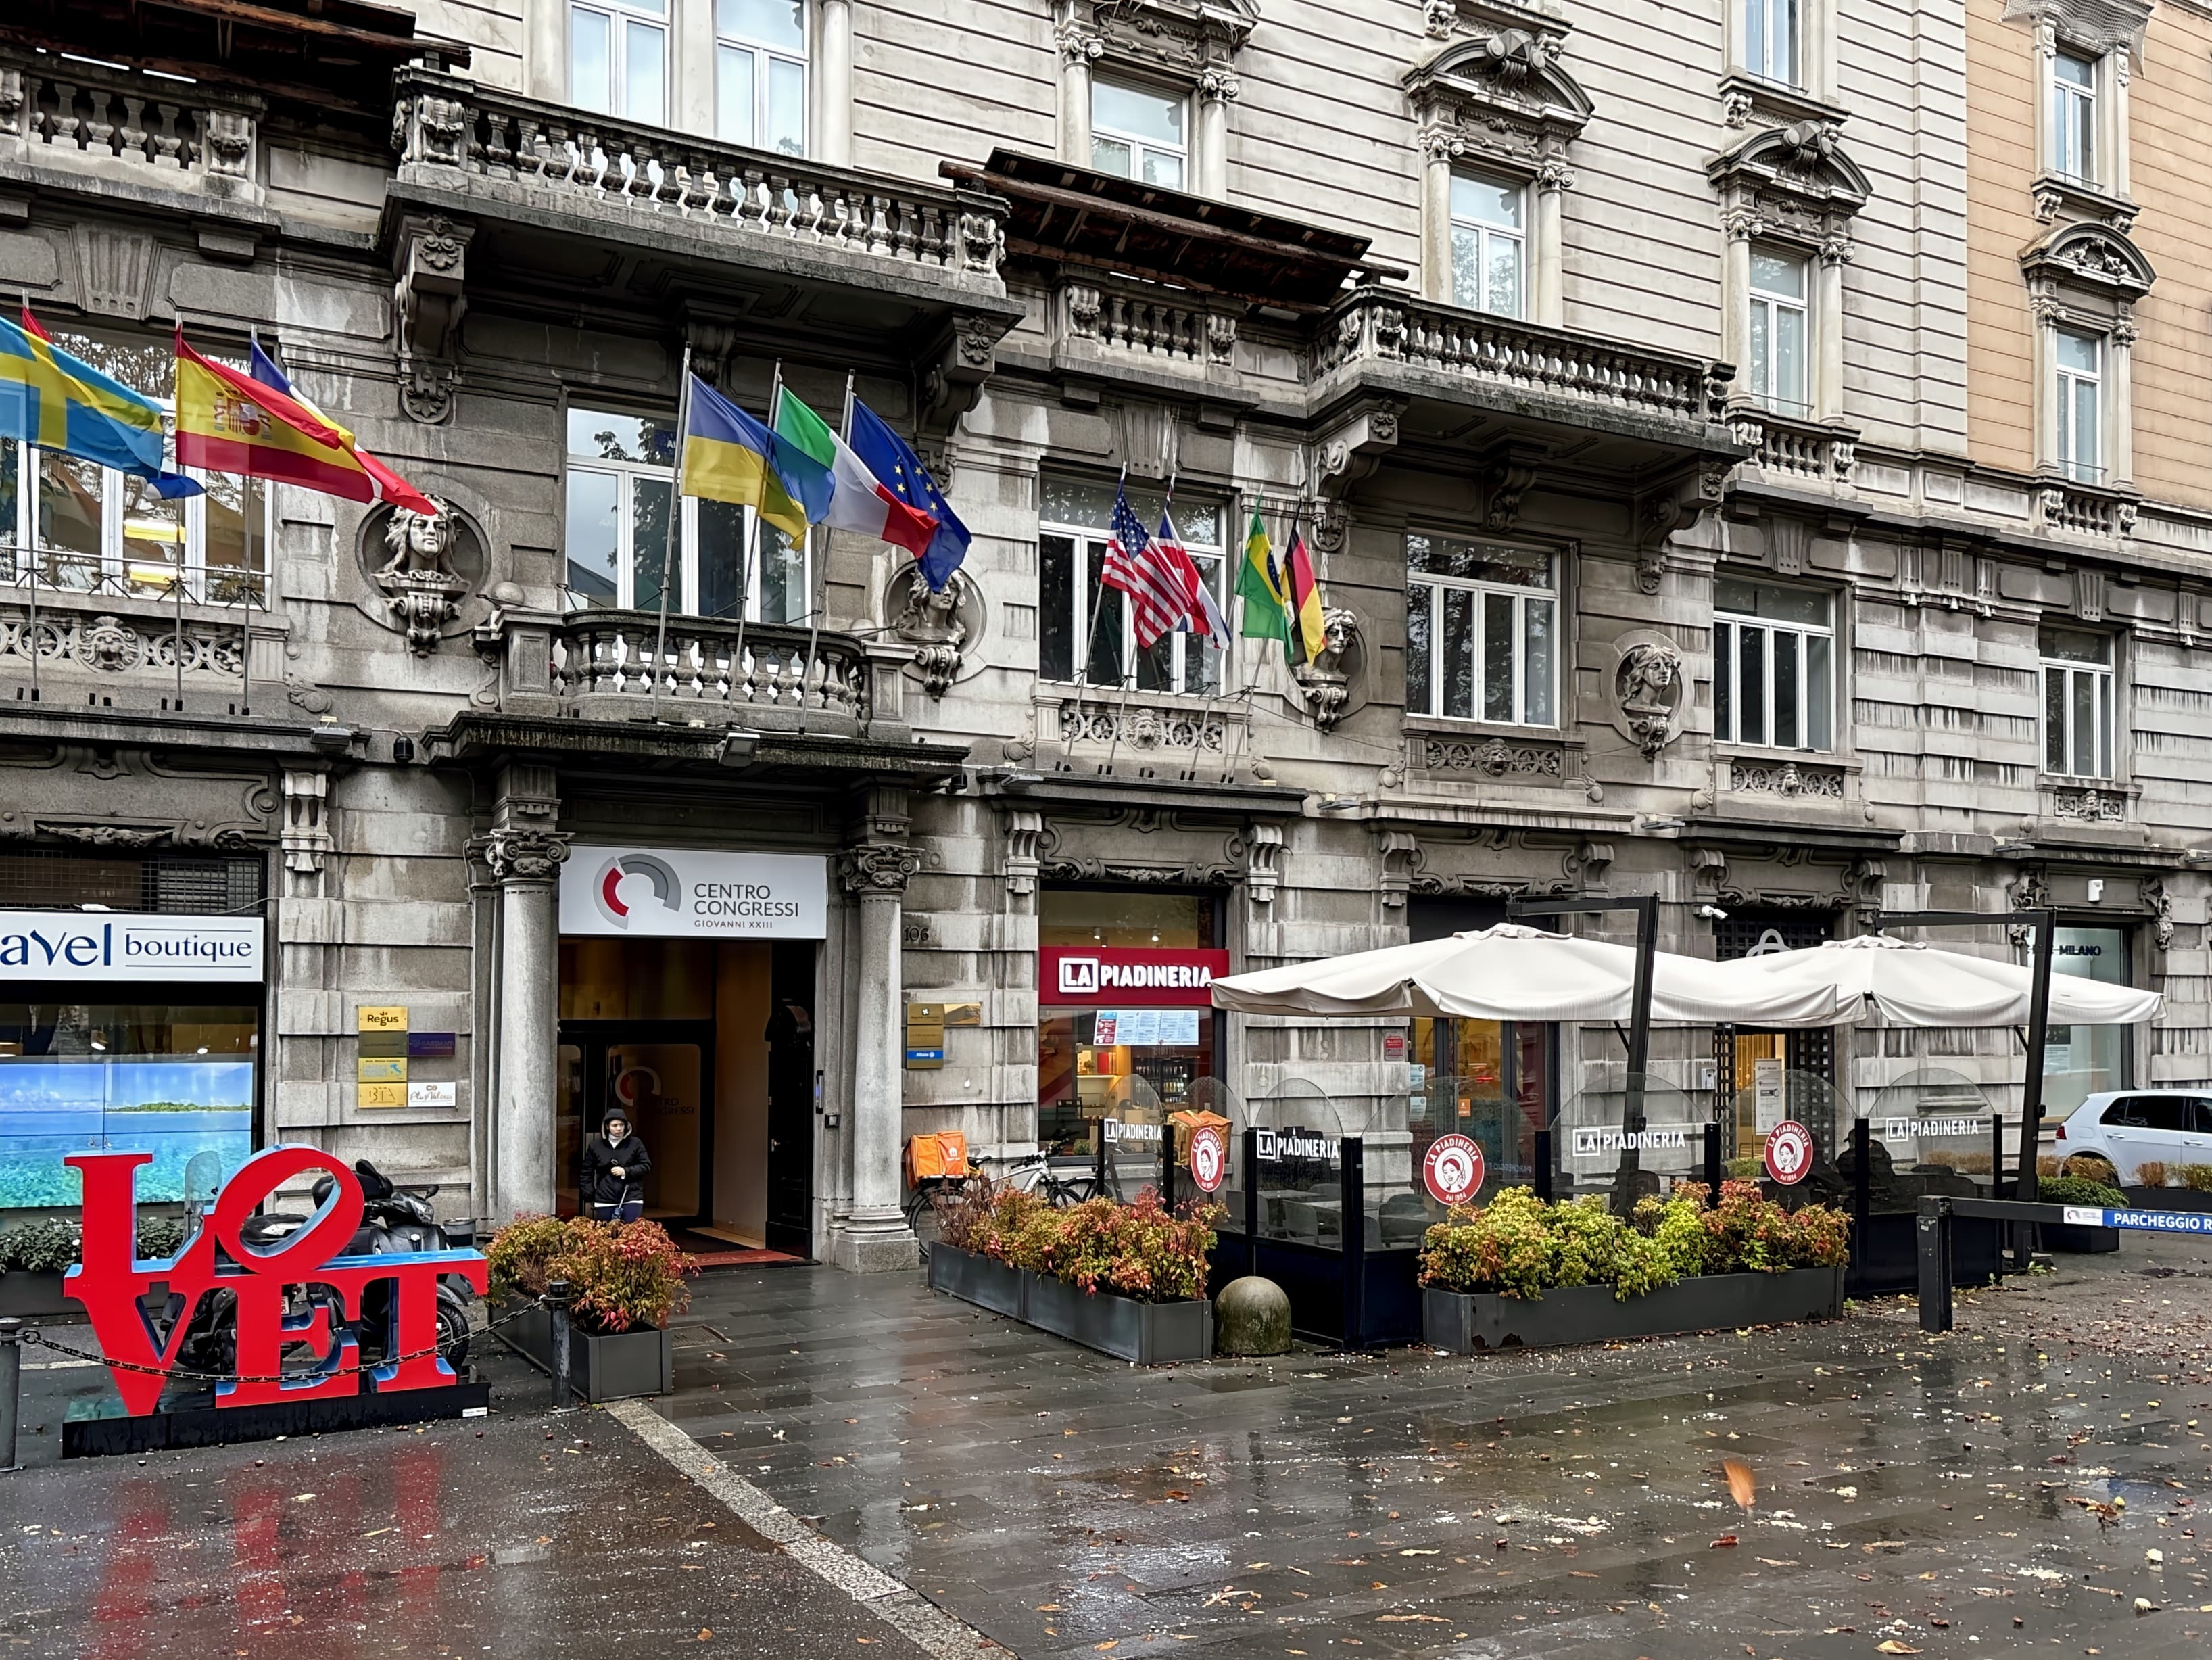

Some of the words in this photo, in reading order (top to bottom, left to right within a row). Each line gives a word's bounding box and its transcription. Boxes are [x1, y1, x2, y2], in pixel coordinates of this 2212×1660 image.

[694, 883, 771, 899] CENTRO
[694, 900, 799, 917] CONGRESSI
[694, 920, 745, 928] GIOVANNI
[748, 921, 773, 929] XXIII
[903, 927, 930, 942] 106
[125, 934, 253, 962] boutique
[2059, 945, 2102, 956] MILANO
[1065, 964, 1092, 987] LA
[1101, 965, 1212, 987] PIADINERIA
[367, 1014, 399, 1026] Regus
[1106, 1121, 1116, 1138] LA
[1118, 1124, 1163, 1141] PIADINERIA
[1768, 1137, 1776, 1148] LA
[1775, 1124, 1810, 1148] PIADINERIA
[1890, 1122, 1905, 1137] LA
[1910, 1120, 1979, 1137] PIADINERIA
[1193, 1142, 1199, 1154] LA
[1197, 1131, 1222, 1156] PIADINERIA
[1259, 1136, 1273, 1154] LA
[1276, 1137, 1339, 1159] PIADINERIA
[1577, 1135, 1596, 1152] LA
[1603, 1131, 1686, 1150] PIADINERIA
[1426, 1153, 1437, 1166] LA
[1435, 1137, 1480, 1162] PIADINERIA
[1445, 1193, 1454, 1202] dal
[1454, 1191, 1467, 1201] 1994
[2113, 1213, 2201, 1229] PARCHEGGIO
